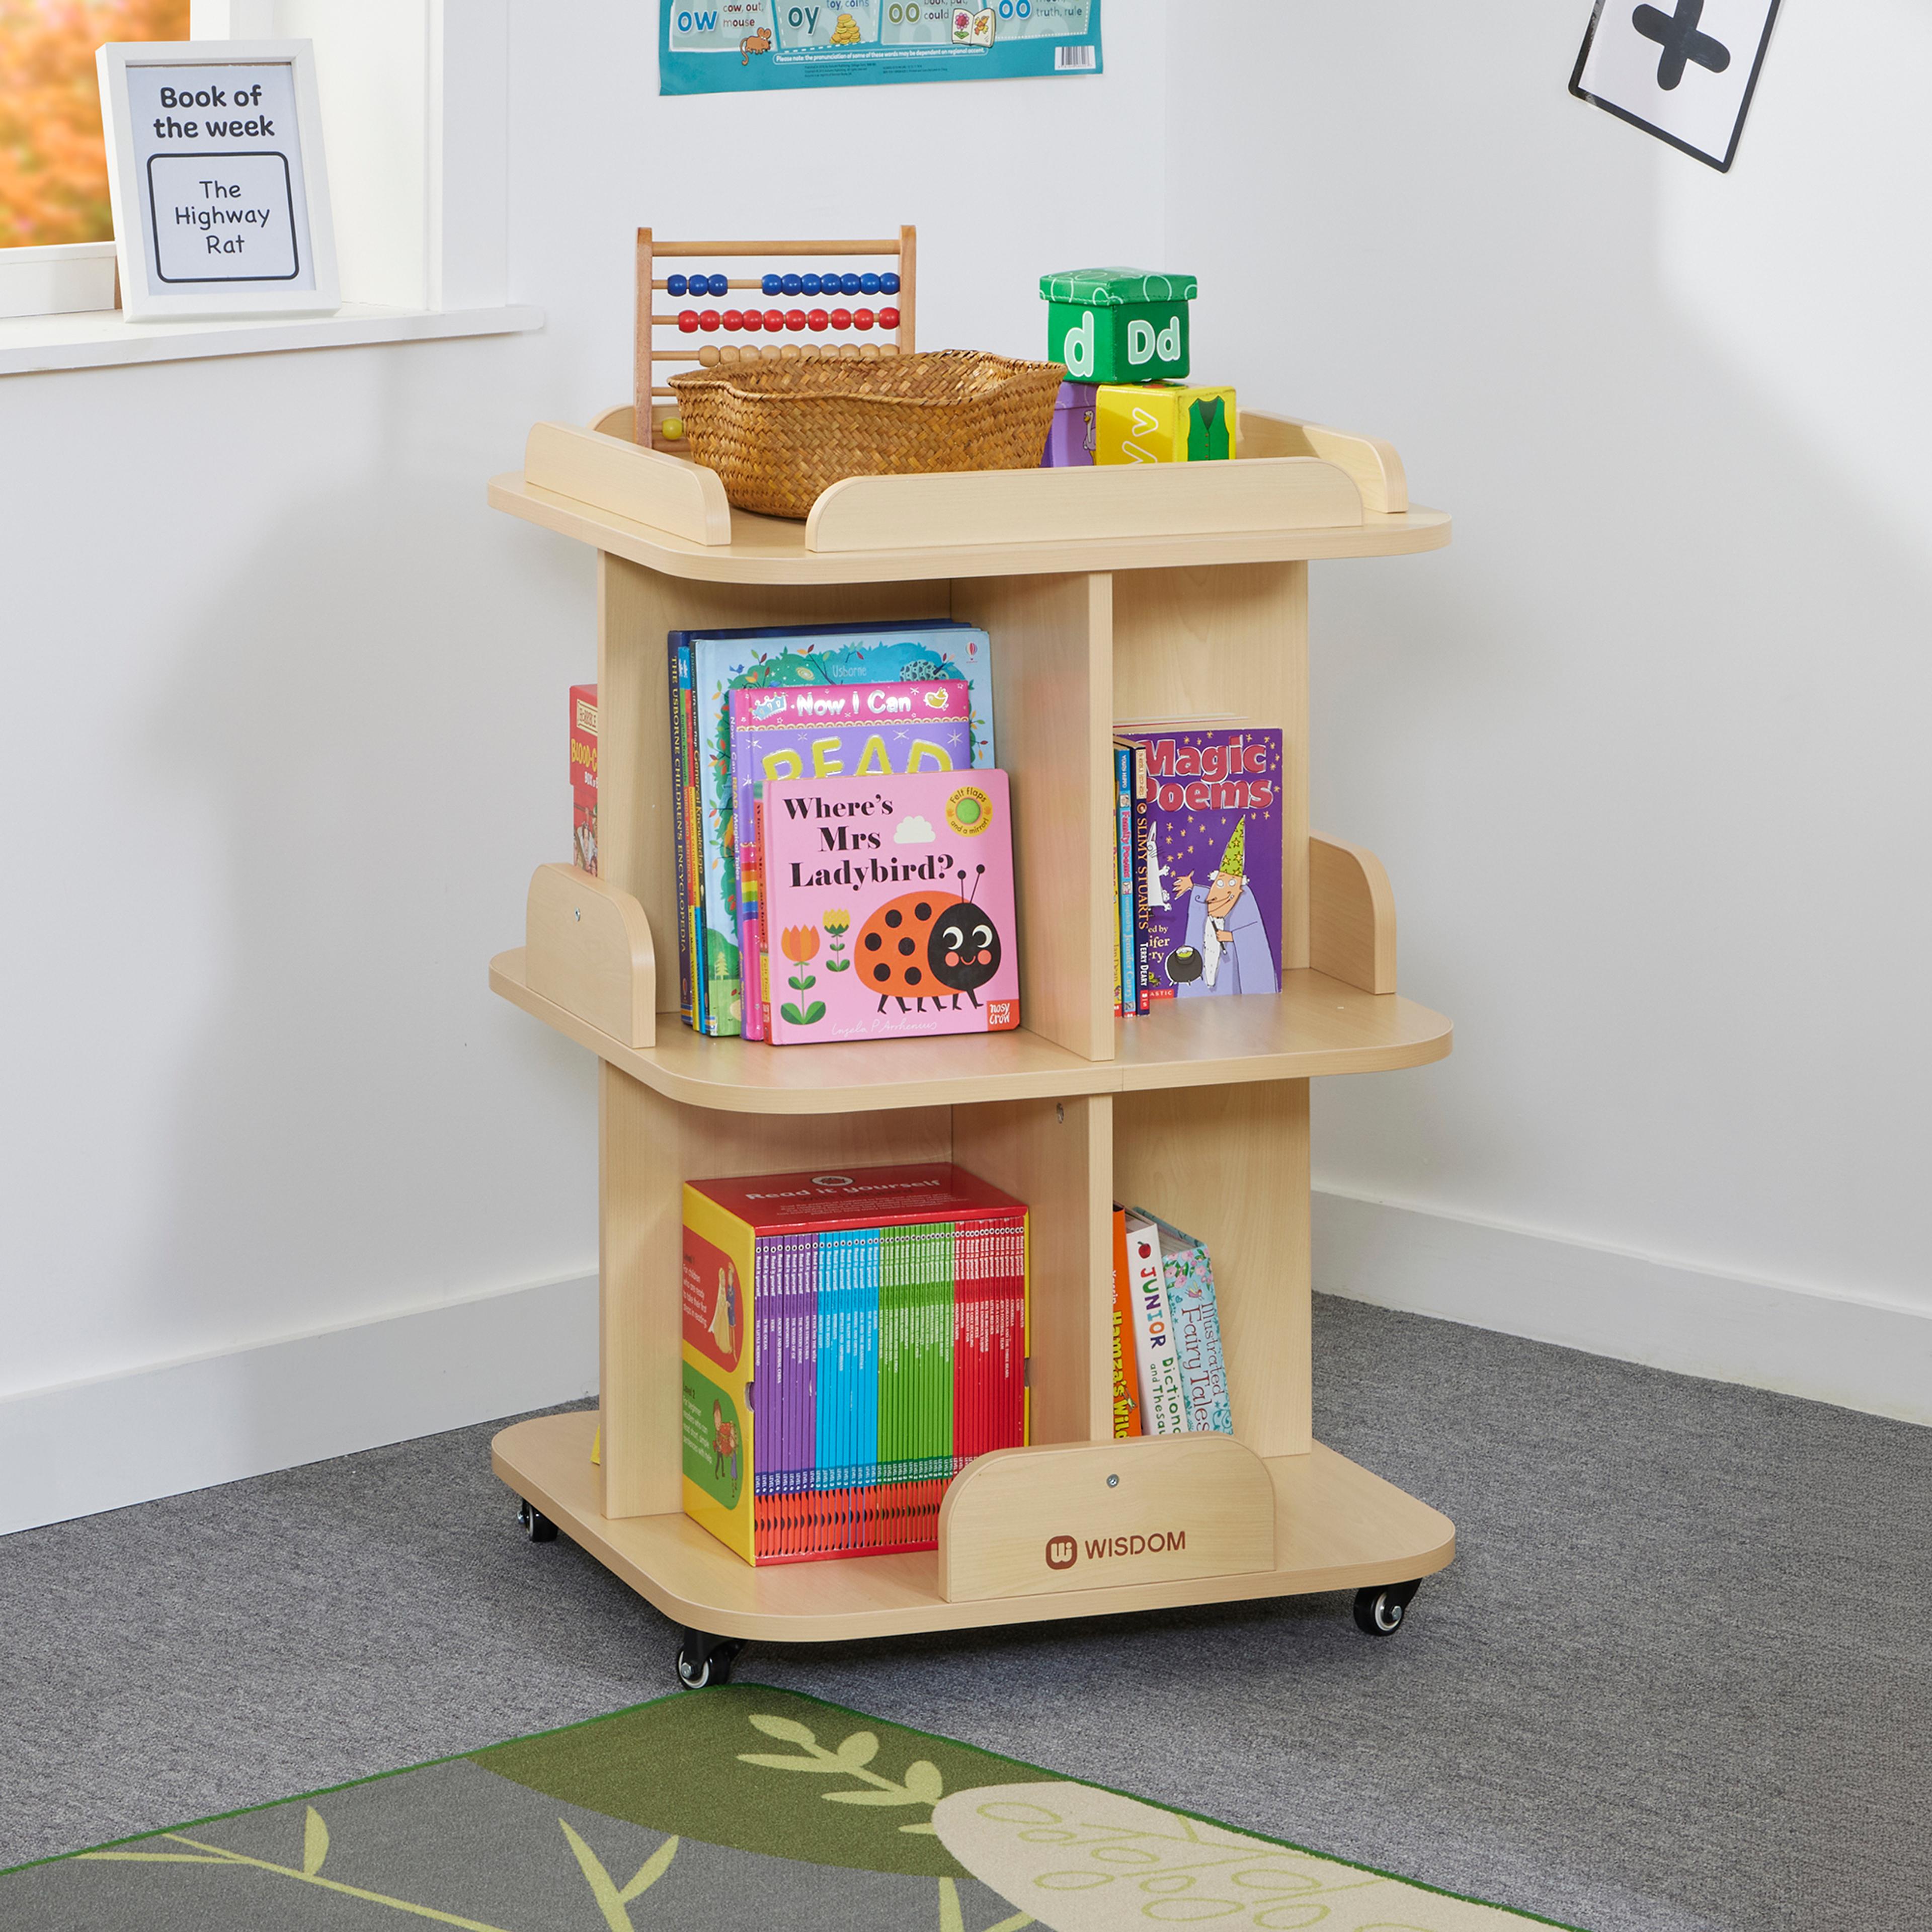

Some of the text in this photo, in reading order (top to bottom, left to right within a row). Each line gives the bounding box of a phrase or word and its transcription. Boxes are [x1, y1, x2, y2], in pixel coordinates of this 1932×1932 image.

[678, 11, 717, 32] ow
[723, 18, 755, 27] mouse
[788, 6, 820, 34] oy
[889, 3, 920, 24] oo
[924, 9, 948, 19] could
[999, 0, 1030, 19] oo
[1065, 6, 1082, 16] rule
[814, 53, 846, 61] pronunciation
[160, 85, 262, 108] Book of
[153, 115, 275, 138] the week
[199, 180, 241, 198] The
[175, 206, 270, 230] Highway
[206, 234, 245, 254] Rat
[1064, 311, 1094, 377] d
[1128, 316, 1181, 365] Dd
[833, 665, 867, 678] Usborne
[797, 690, 911, 716] Now I Can
[1139, 735, 1266, 783] Magic
[783, 794, 894, 820] Where's
[950, 786, 987, 803] Felt flaps
[696, 806, 704, 873] Knowledge
[819, 826, 881, 852] Mrs
[950, 821, 963, 832] and
[1120, 811, 1132, 877] Family Poems
[789, 853, 954, 891] Ladybird?
[1137, 818, 1149, 930] SLIMY STUARTS
[678, 845, 686, 952] ENCYCLOPEDIA
[1159, 925, 1168, 934] by
[1124, 934, 1134, 968] Jennifer
[1140, 942, 1149, 986] TERRY DEARY
[1126, 971, 1135, 998] Curry
[990, 1003, 1010, 1015] nosy
[746, 1189, 811, 1200] Read
[816, 1186, 837, 1194] it
[843, 1179, 941, 1193] yourself
[1140, 1266, 1167, 1349] JUNIOR
[1113, 1311, 1127, 1396] Hamza's
[1201, 1302, 1225, 1396] Illustrated
[1150, 1363, 1160, 1383] and
[1181, 1307, 1213, 1432] Fairy Tales
[1085, 1531, 1185, 1559] WISDOM
